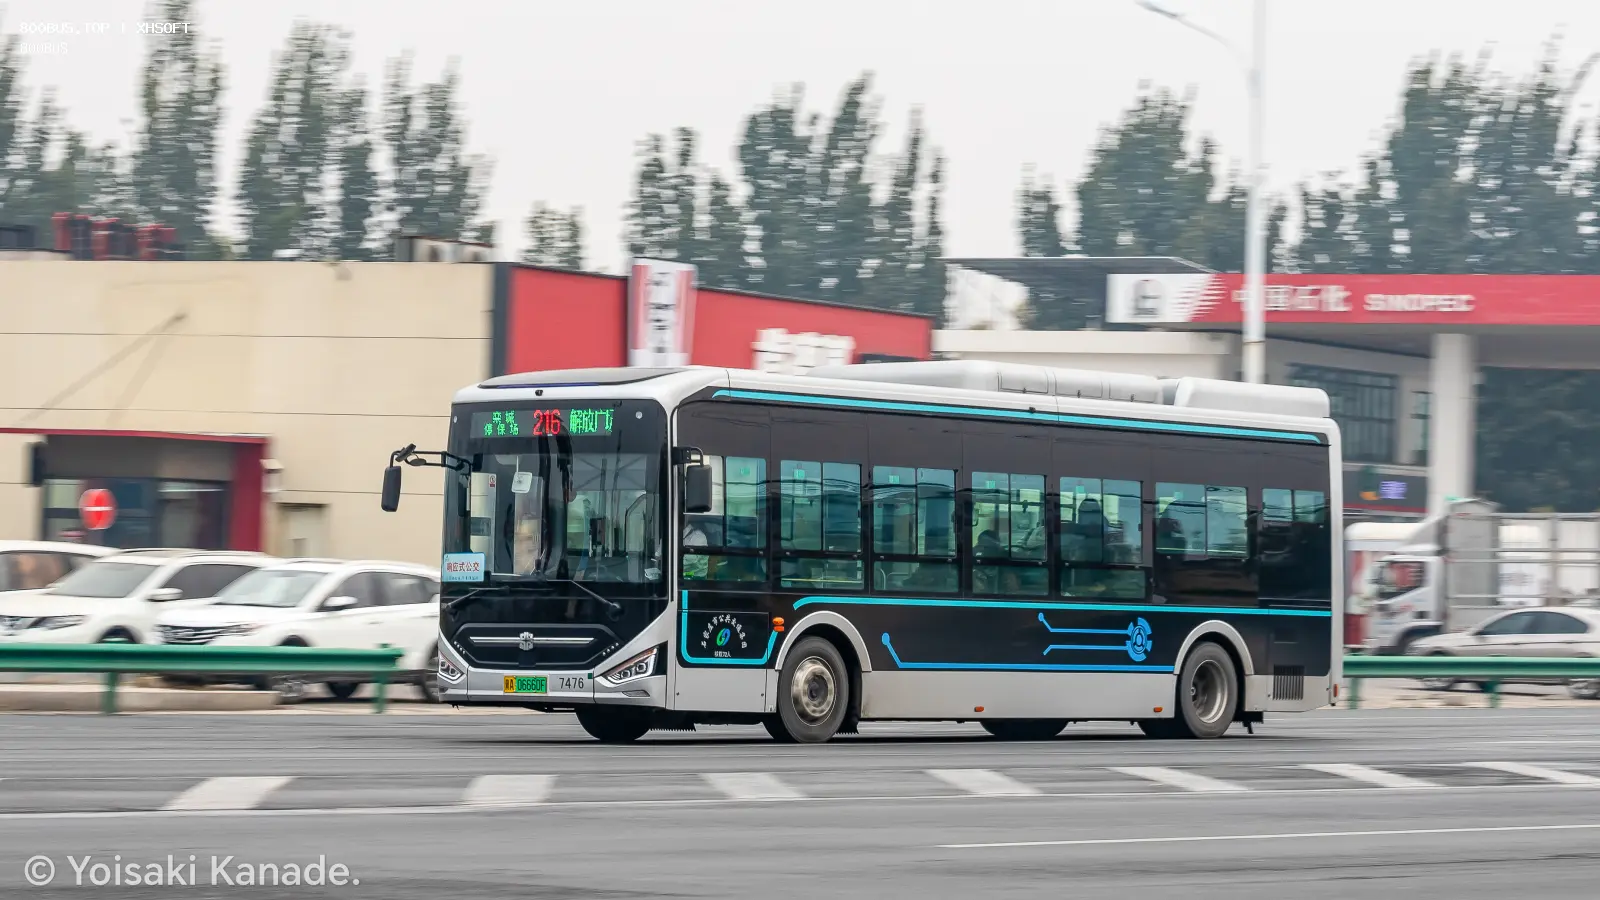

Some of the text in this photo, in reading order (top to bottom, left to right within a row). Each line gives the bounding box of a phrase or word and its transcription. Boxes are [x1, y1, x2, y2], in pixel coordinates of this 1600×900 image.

[533, 409, 561, 436] 216
[484, 423, 519, 436] 停保场
[446, 561, 480, 573] 响应式公交
[559, 677, 584, 689] 7476
